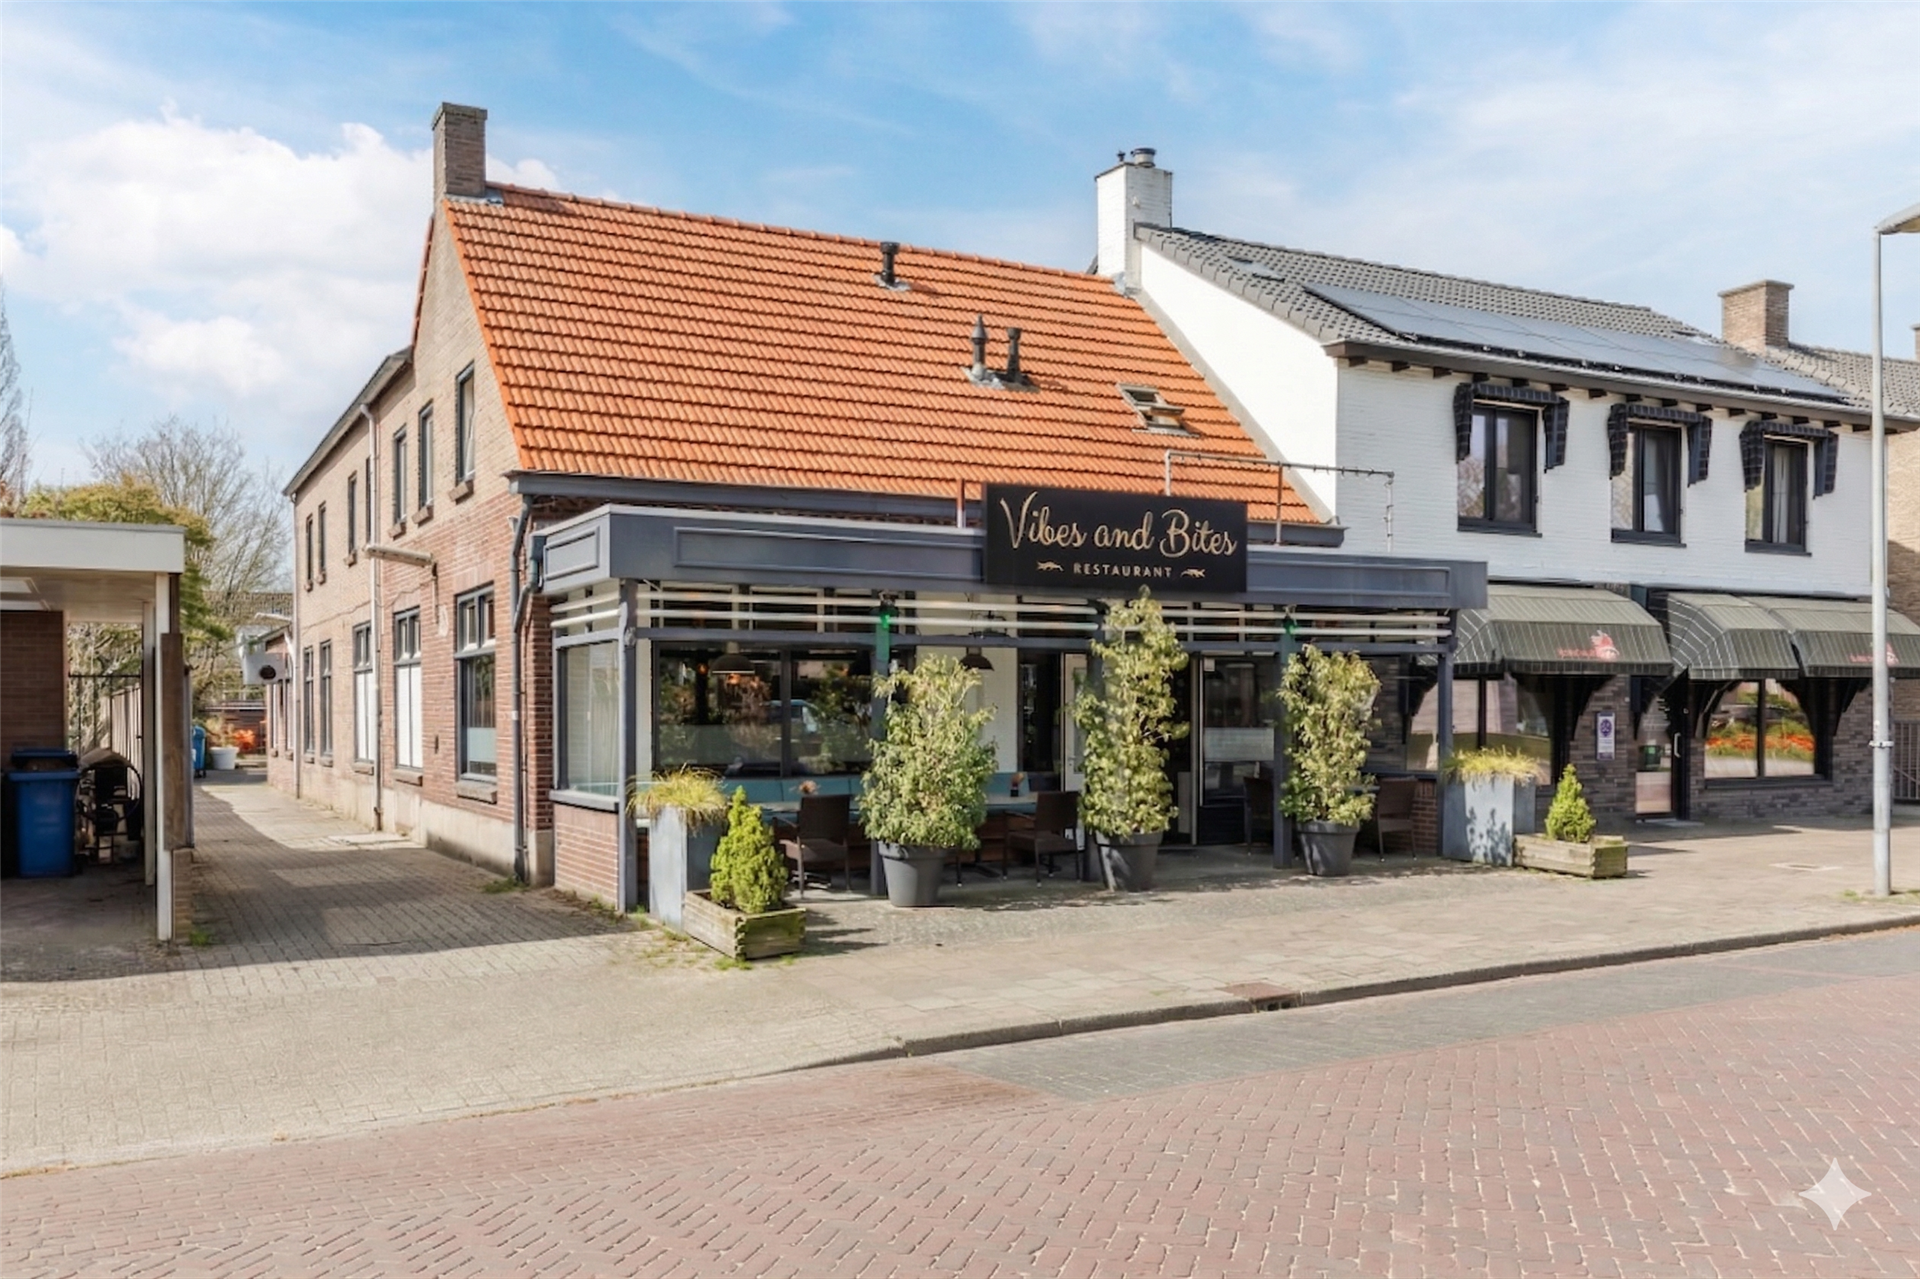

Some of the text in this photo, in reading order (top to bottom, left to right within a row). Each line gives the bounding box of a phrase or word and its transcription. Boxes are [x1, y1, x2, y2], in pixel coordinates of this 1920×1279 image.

[1000, 491, 1237, 558] Vibes and Bites
[1073, 562, 1172, 578] RESTAURANT
